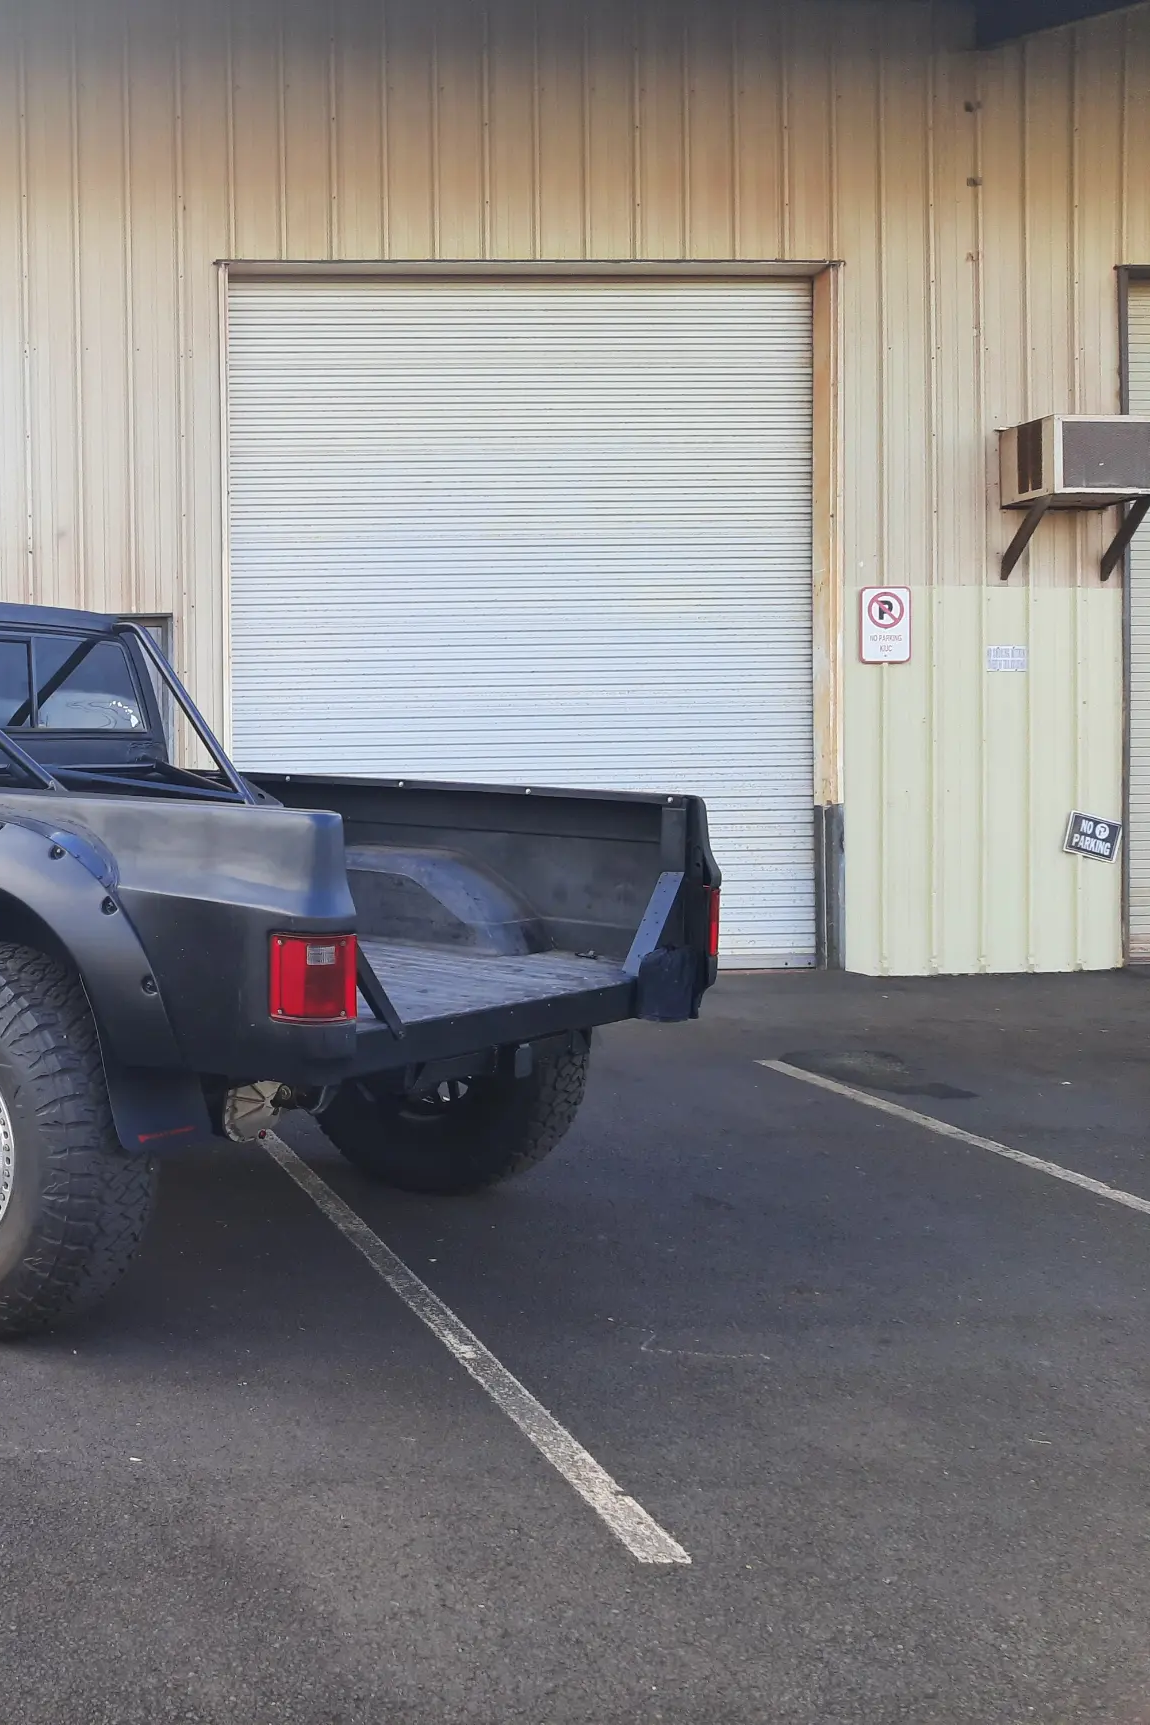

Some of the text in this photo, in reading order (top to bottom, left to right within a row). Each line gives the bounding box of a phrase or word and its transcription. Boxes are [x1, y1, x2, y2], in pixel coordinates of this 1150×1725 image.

[869, 634, 903, 642] NO PARKING
[1080, 819, 1094, 834] NO
[1071, 833, 1111, 856] PARKING
